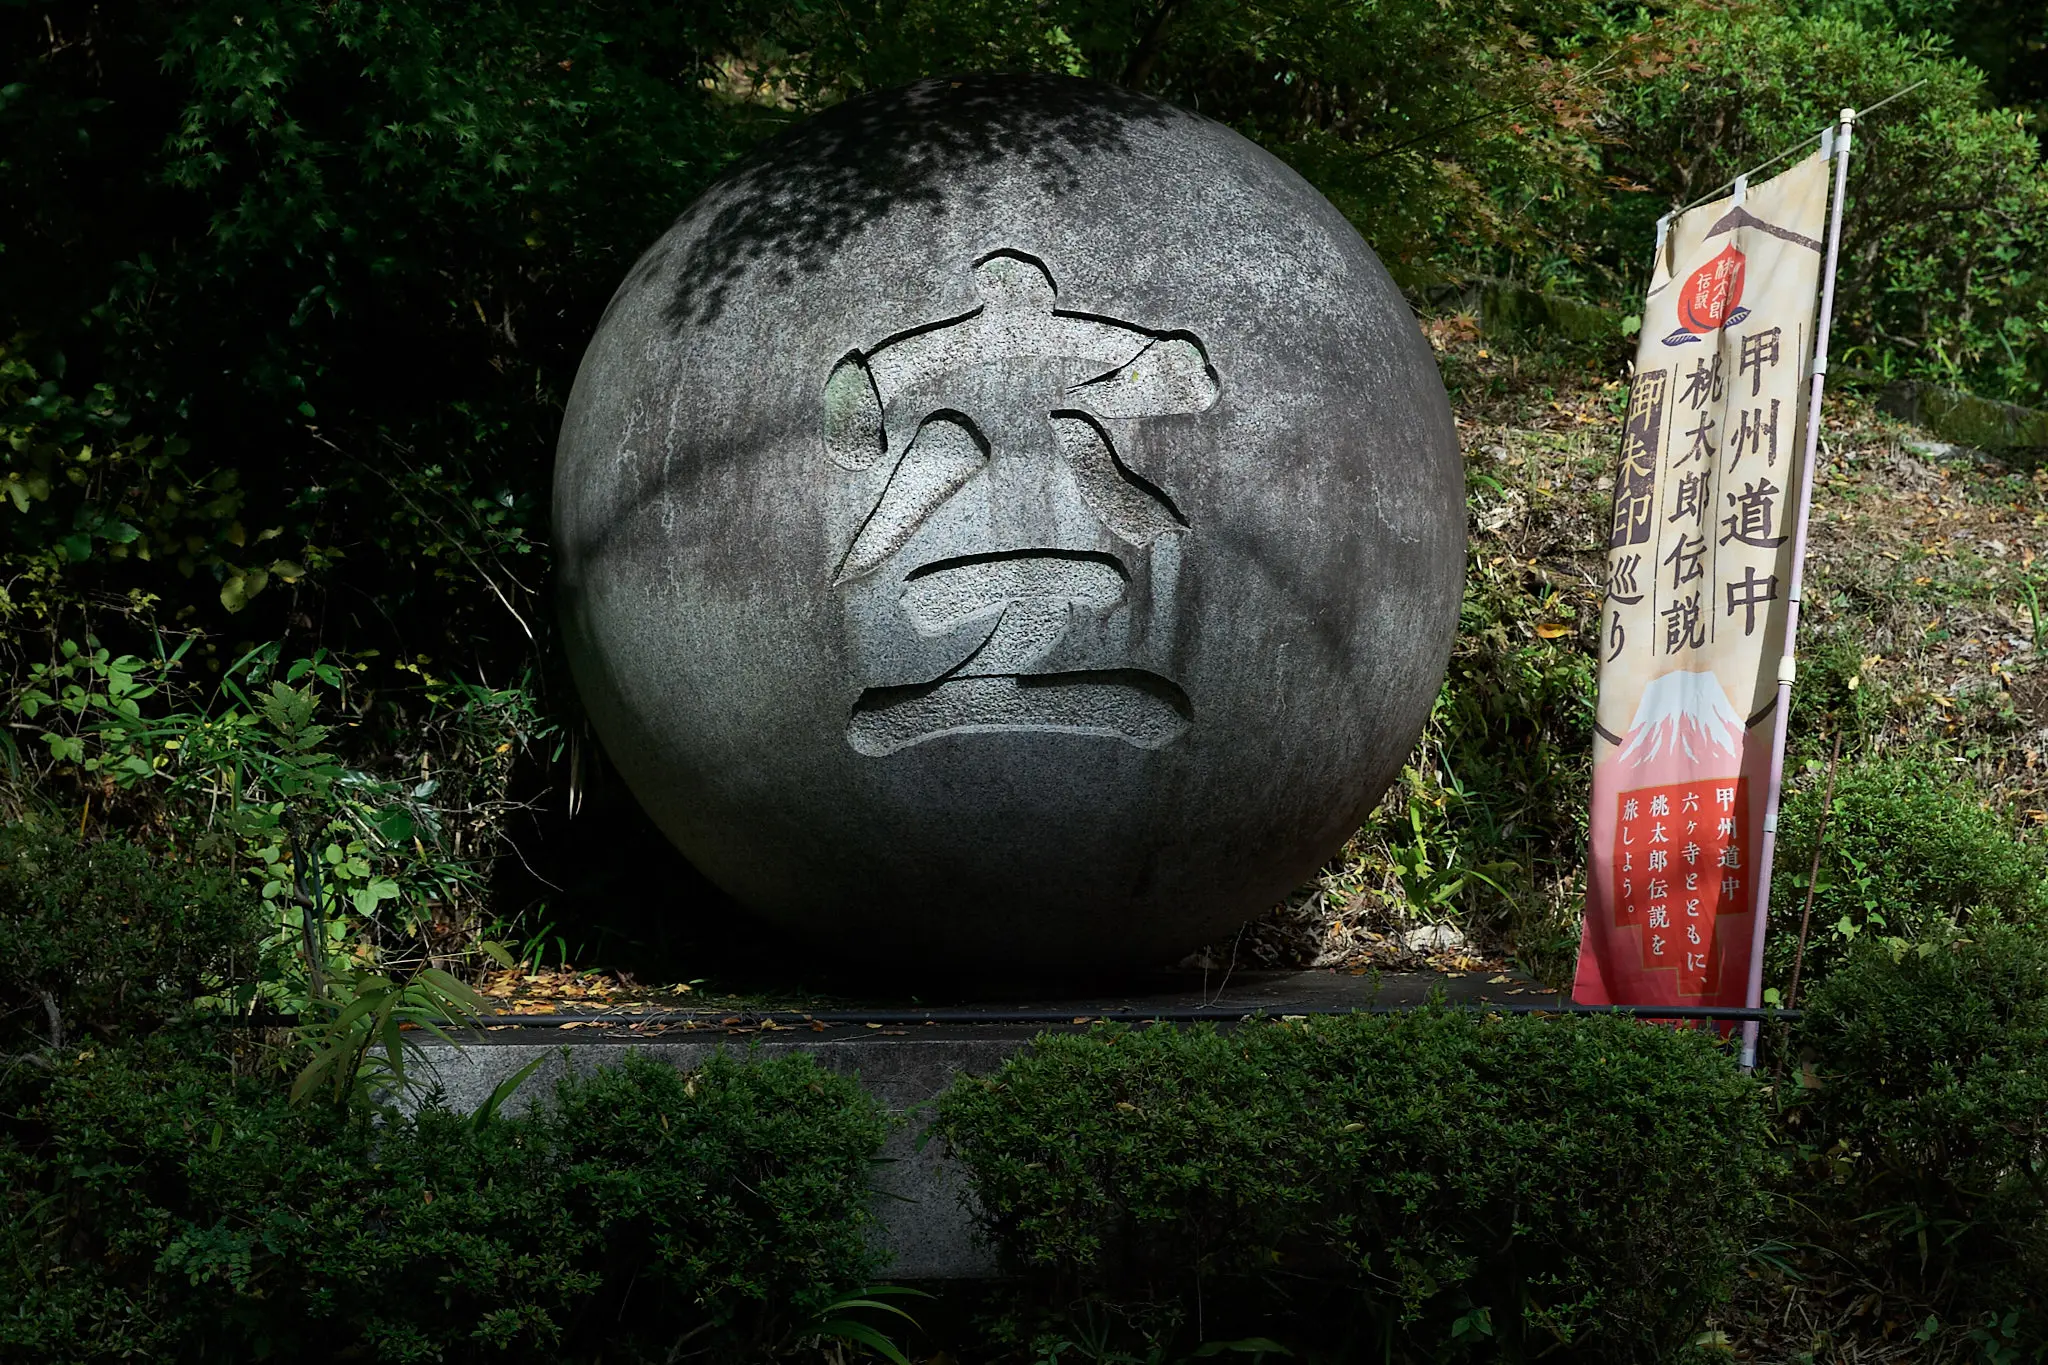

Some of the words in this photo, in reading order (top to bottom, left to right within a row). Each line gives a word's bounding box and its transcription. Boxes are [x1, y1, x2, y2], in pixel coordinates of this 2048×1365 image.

[822, 247, 1220, 757] 空
[1605, 369, 1665, 663] 御朱印巡り
[1661, 353, 1724, 656] 桃太郎伝説
[1719, 326, 1788, 636] 甲州道中
[1622, 798, 1639, 913] 旅しよう。
[1647, 794, 1670, 956] 桃太郎伝説を
[1715, 786, 1742, 901] 甲州道中
